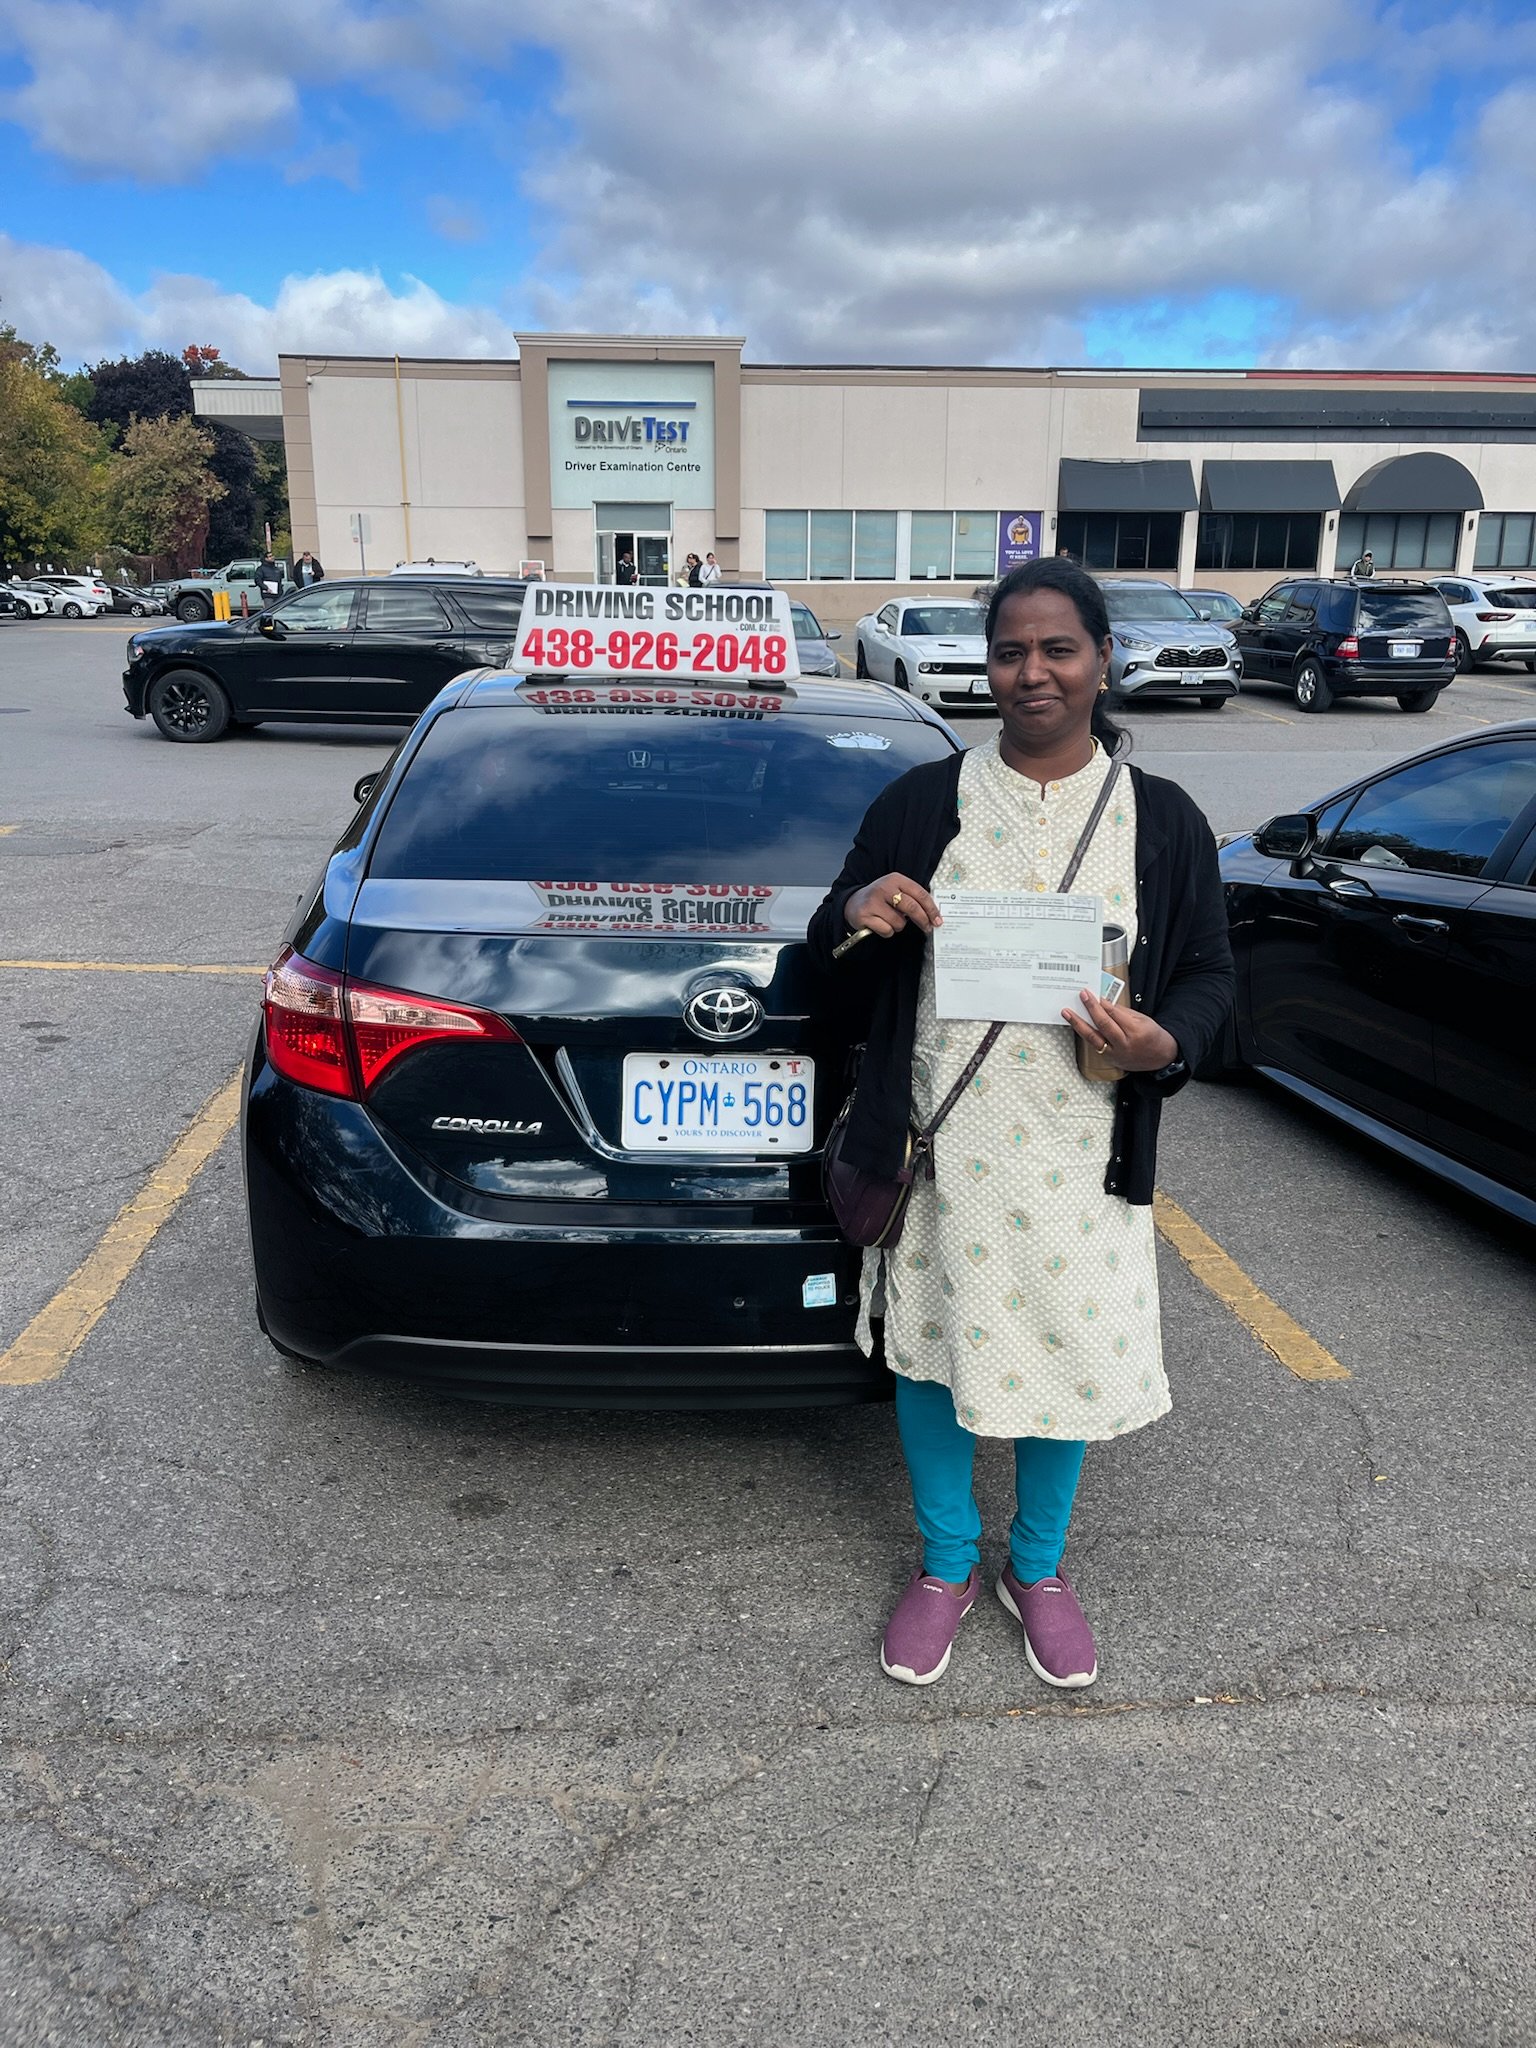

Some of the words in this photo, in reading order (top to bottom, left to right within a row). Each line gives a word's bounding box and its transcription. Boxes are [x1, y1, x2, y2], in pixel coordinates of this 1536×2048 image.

[665, 446, 688, 454] Ontario
[565, 461, 596, 472] Driver
[600, 461, 664, 472] Examination
[667, 462, 701, 472] Centre
[535, 588, 654, 620] DRIVING
[665, 592, 780, 623] SCHOOL
[522, 628, 787, 674] 438-926-2048
[683, 1060, 757, 1076] ONTARIO
[634, 1080, 719, 1126] CYPM
[744, 1082, 806, 1127] 568
[431, 1116, 543, 1135] COROLLA
[675, 1129, 703, 1137] YOURS
[706, 1129, 717, 1137] TO
[720, 1129, 762, 1138] DISCOVER
